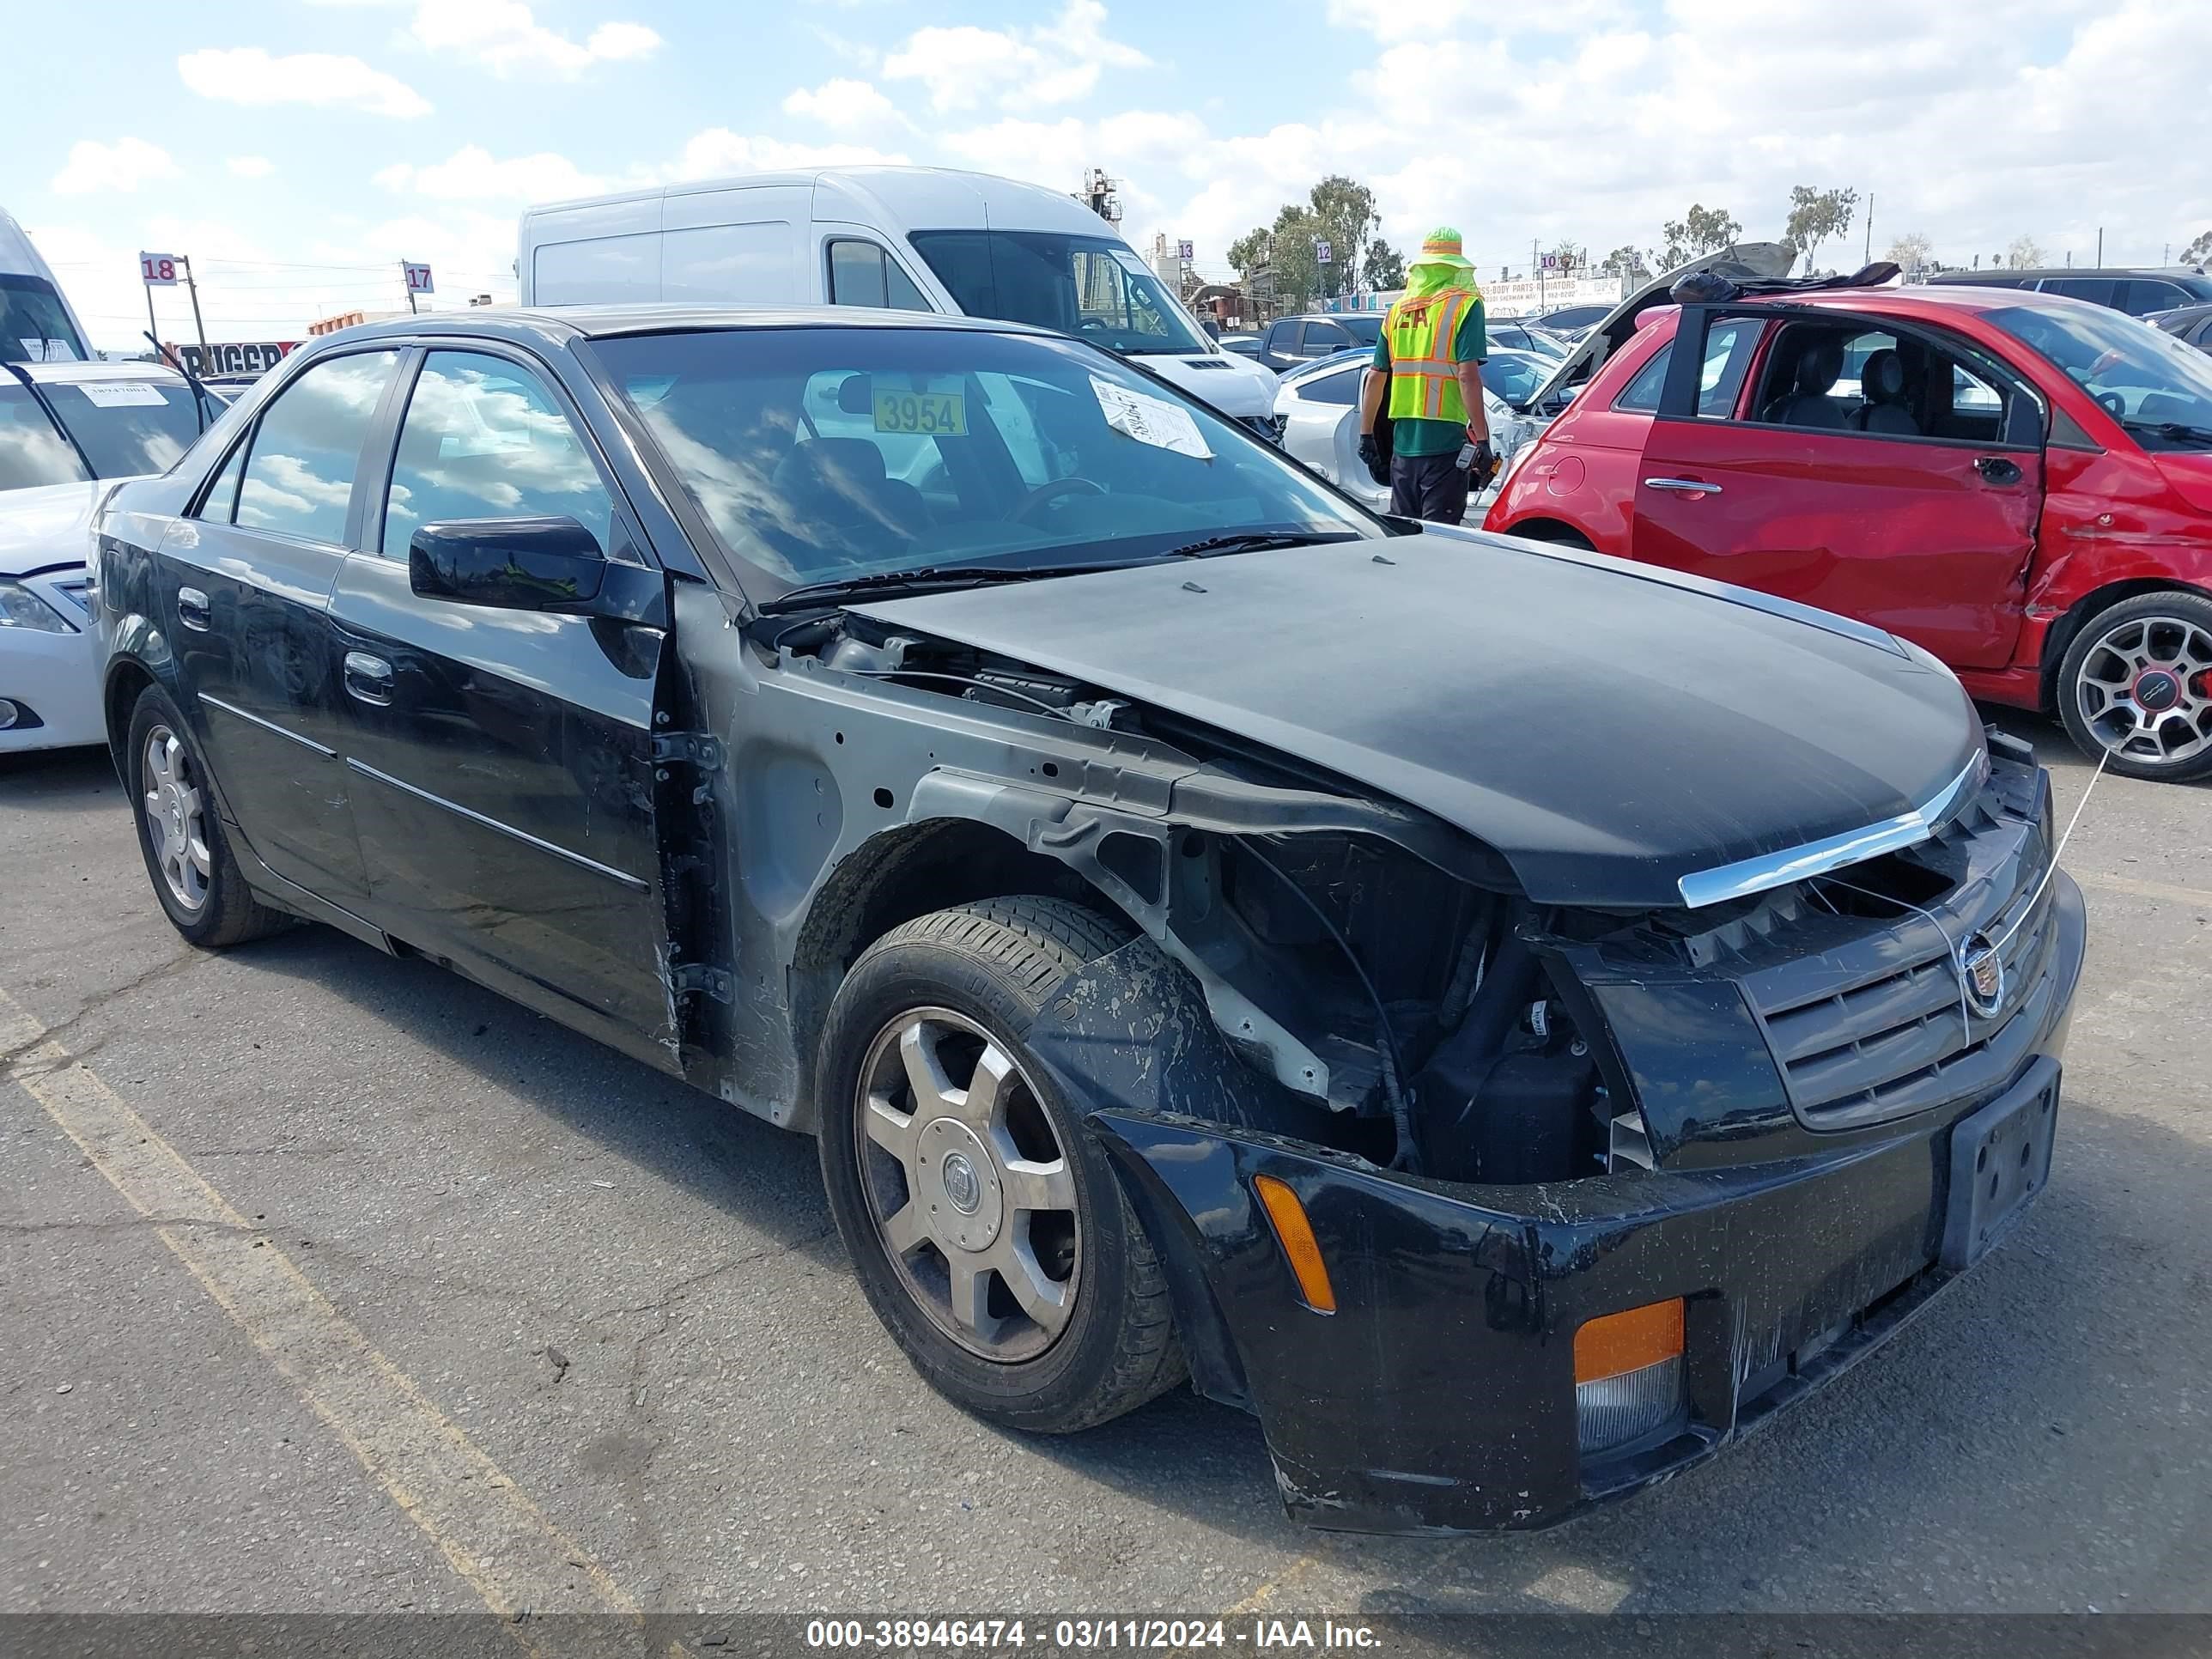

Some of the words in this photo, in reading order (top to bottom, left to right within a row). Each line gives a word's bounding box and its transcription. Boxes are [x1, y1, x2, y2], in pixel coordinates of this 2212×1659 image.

[1180, 244, 1194, 258] 13
[1318, 246, 1332, 259] 12
[1541, 255, 1556, 268] 10
[1634, 256, 1639, 269] 9
[142, 258, 175, 281] 18
[407, 268, 430, 289] 17
[884, 395, 956, 433] 3954
